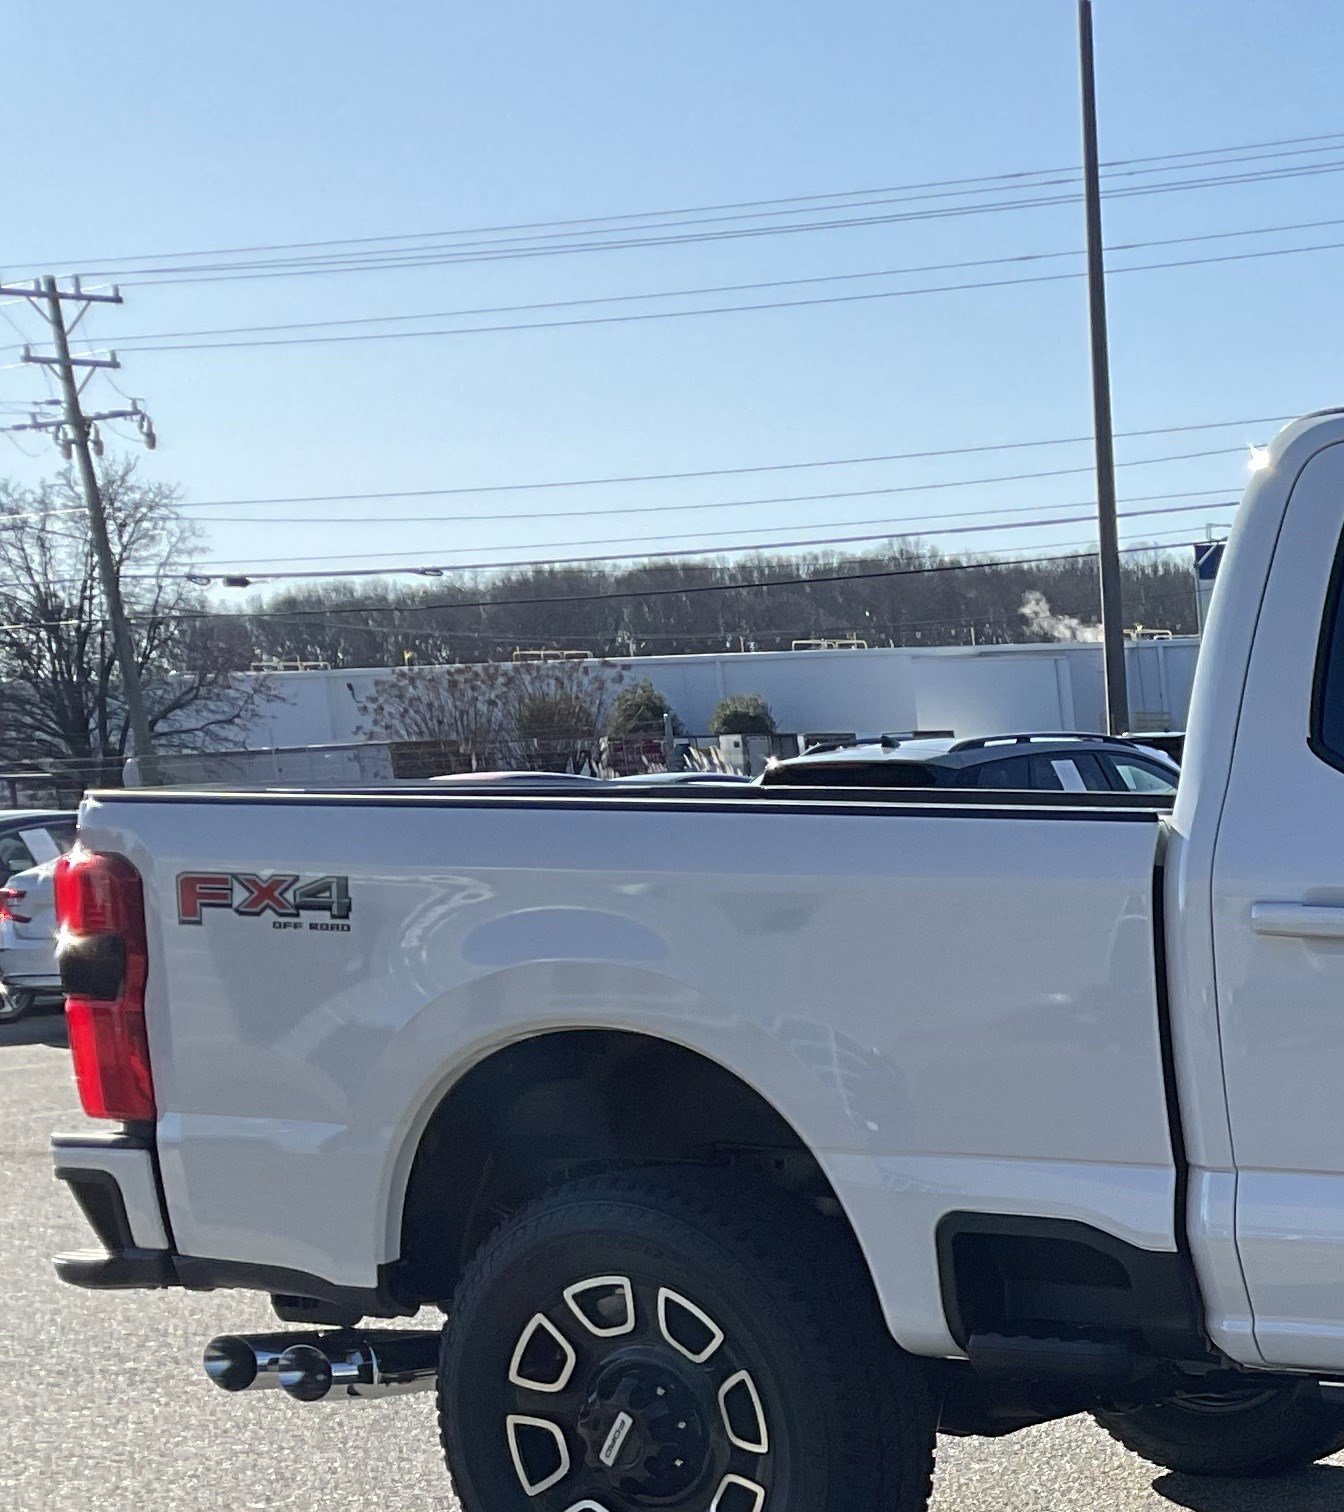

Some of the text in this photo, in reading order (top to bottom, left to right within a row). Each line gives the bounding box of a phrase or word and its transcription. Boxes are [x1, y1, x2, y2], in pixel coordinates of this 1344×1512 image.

[176, 871, 352, 926] FX4
[272, 921, 351, 932] OFF ROAD
